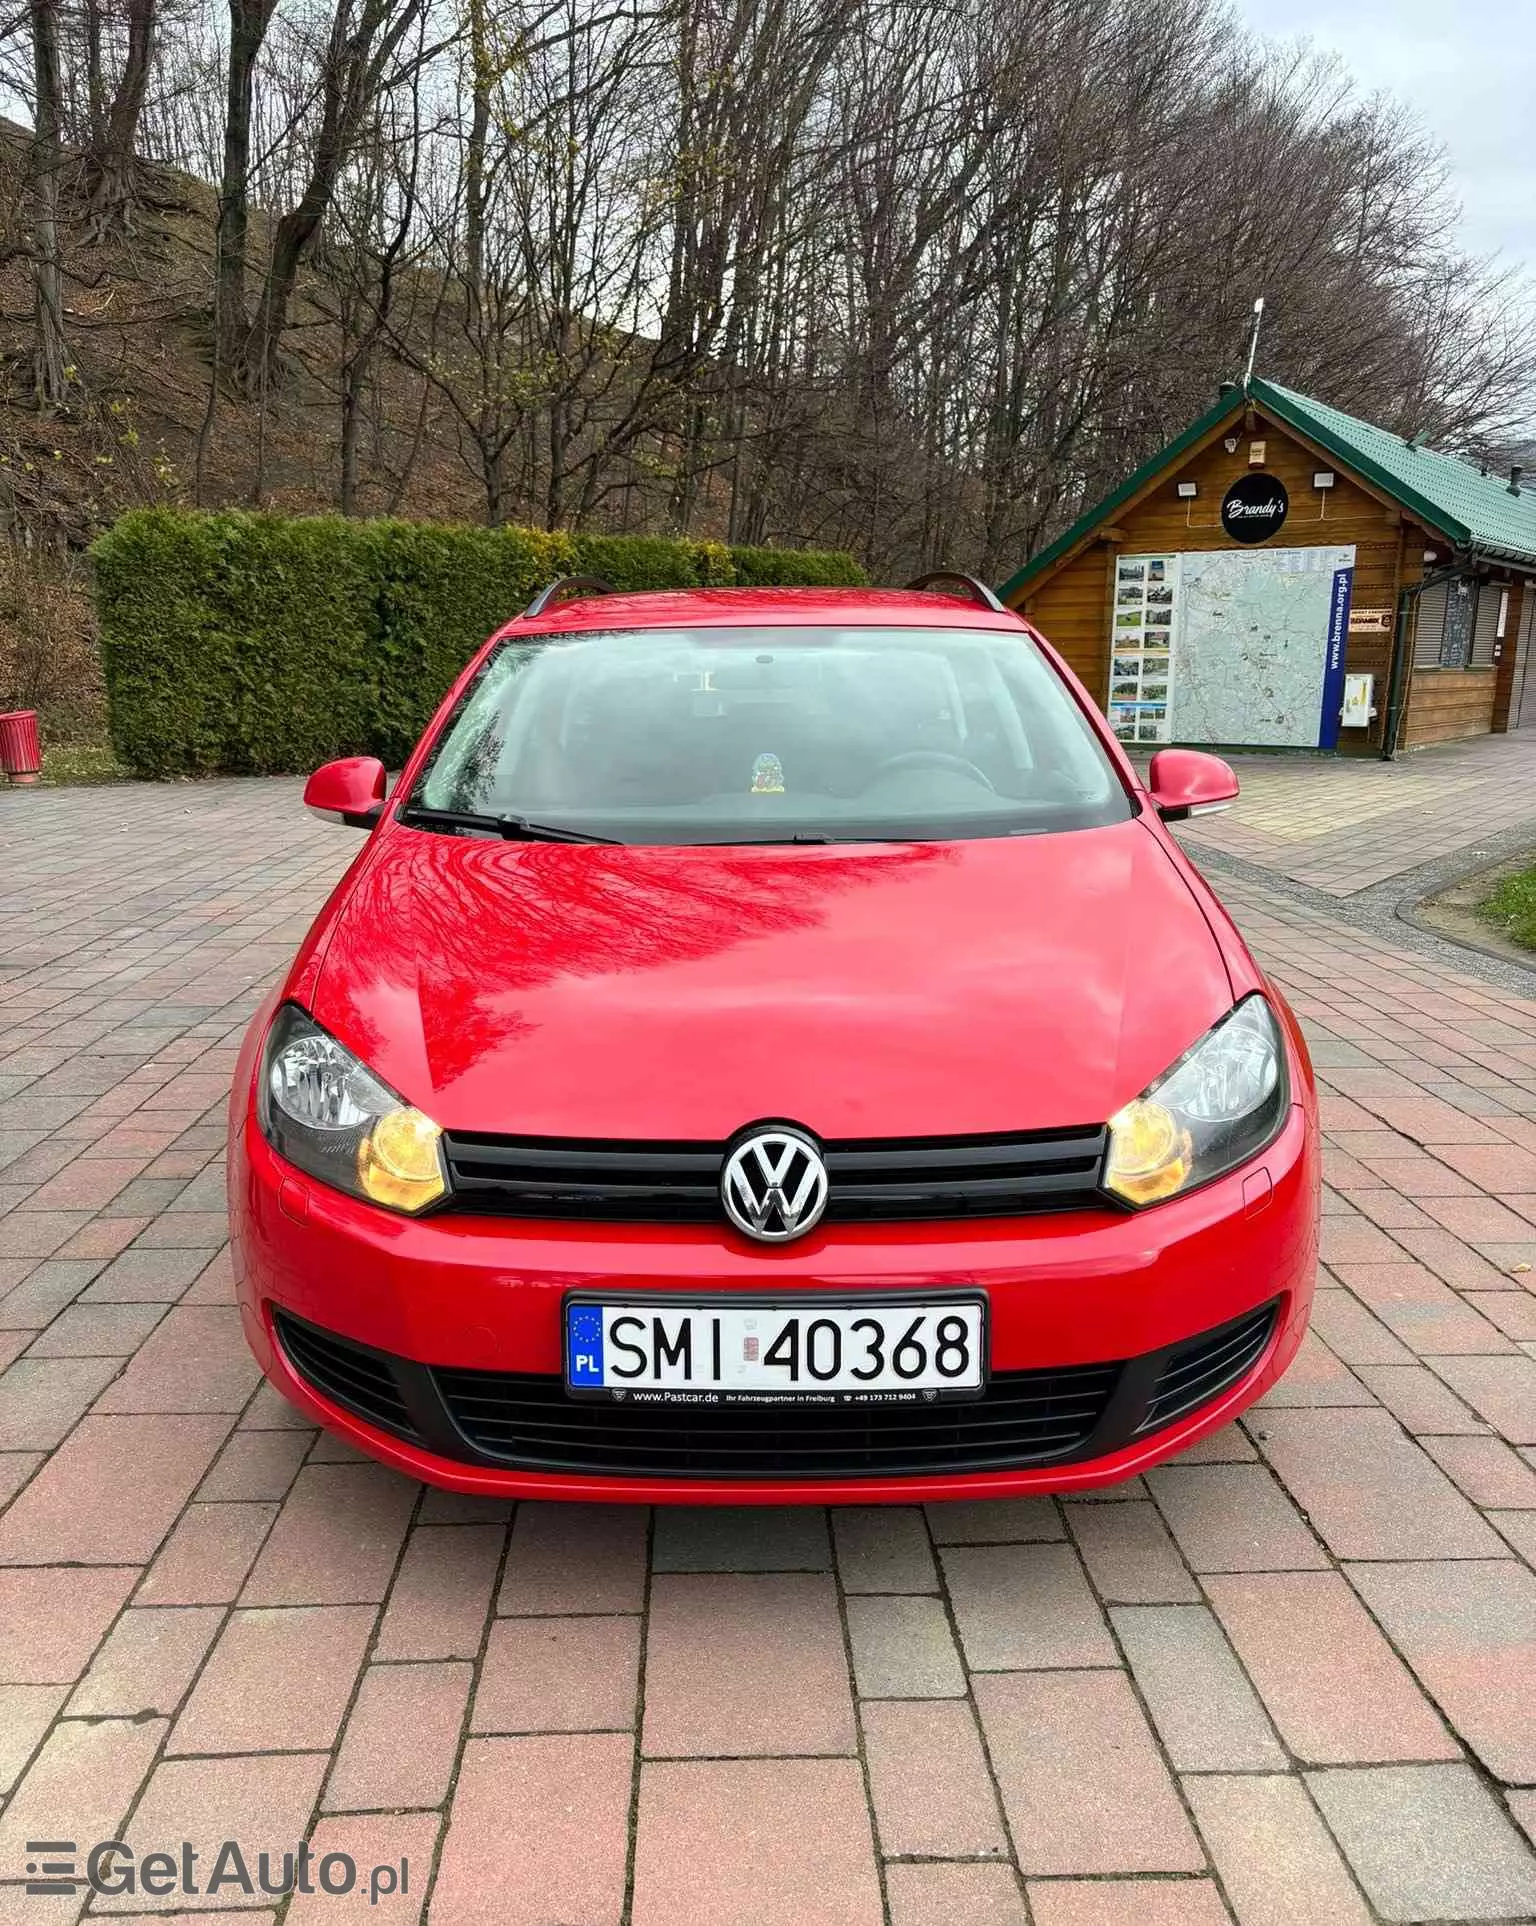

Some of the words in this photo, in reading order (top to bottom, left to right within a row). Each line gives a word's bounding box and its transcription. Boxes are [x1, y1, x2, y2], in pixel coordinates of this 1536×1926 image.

[1226, 497, 1284, 519] Brandy's
[1331, 573, 1348, 670] www.brenna.org.pl
[724, 1132, 828, 1240] VW
[576, 1355, 600, 1374] PL
[608, 1316, 721, 1382] SMI
[764, 1315, 970, 1382] 40368
[632, 1391, 719, 1403] www.Pastcar.de
[726, 1394, 736, 1402] Ihr
[738, 1394, 796, 1403] Fahrzeugpartner
[797, 1394, 804, 1402] in
[805, 1394, 836, 1403] Freiburg
